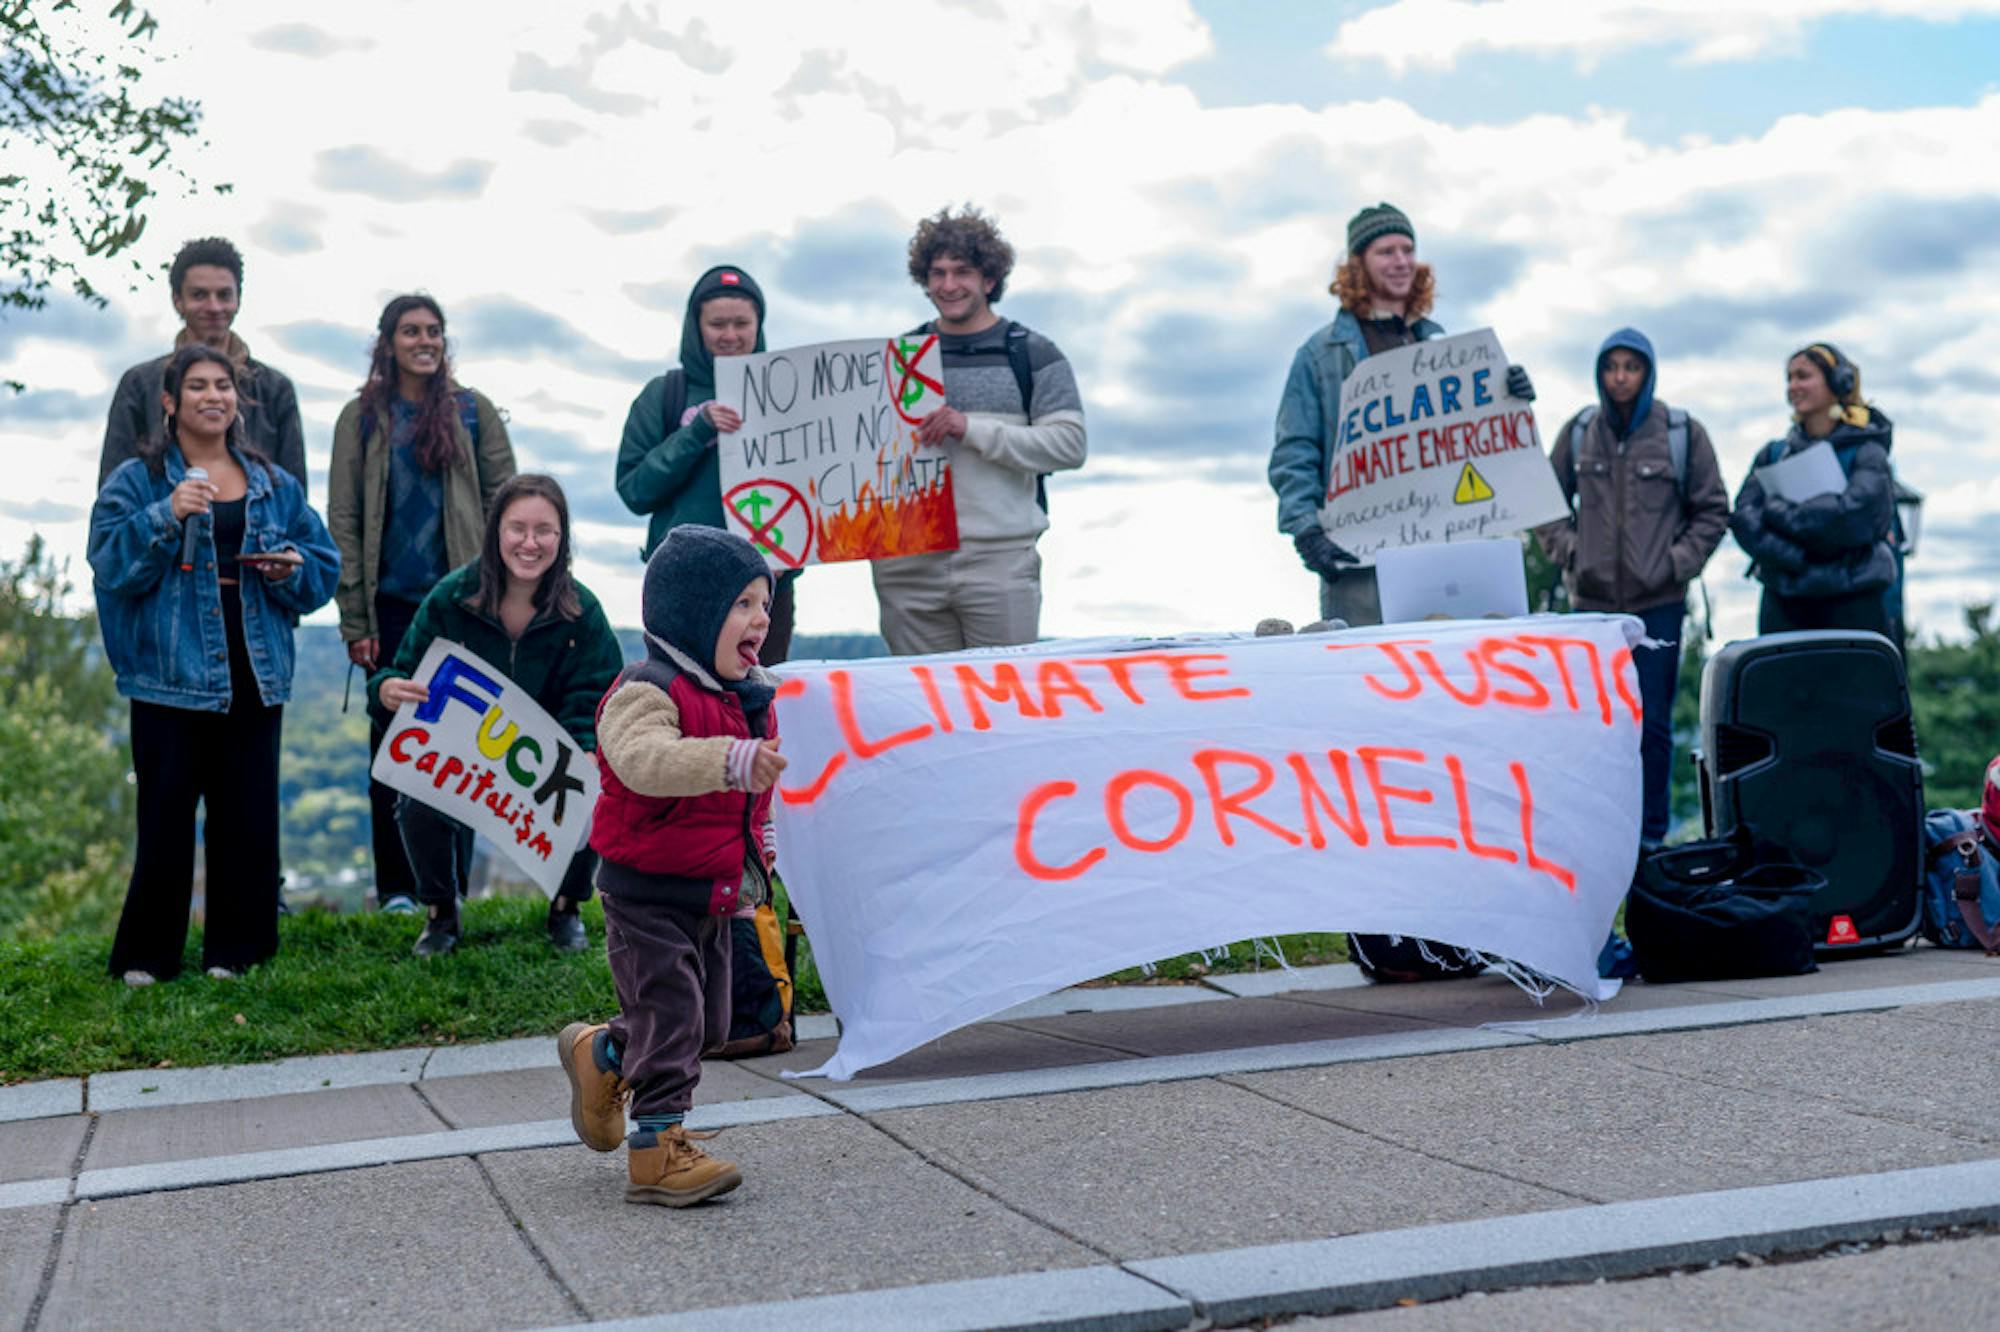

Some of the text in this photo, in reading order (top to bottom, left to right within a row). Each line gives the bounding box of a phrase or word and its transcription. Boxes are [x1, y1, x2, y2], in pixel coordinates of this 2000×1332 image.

[742, 349, 886, 423] NO MONEY
[743, 404, 893, 469] WITH NO
[1418, 410, 1537, 469] EMERGENCY
[414, 653, 585, 826] FUCK
[1013, 745, 1577, 894] CORNELL
